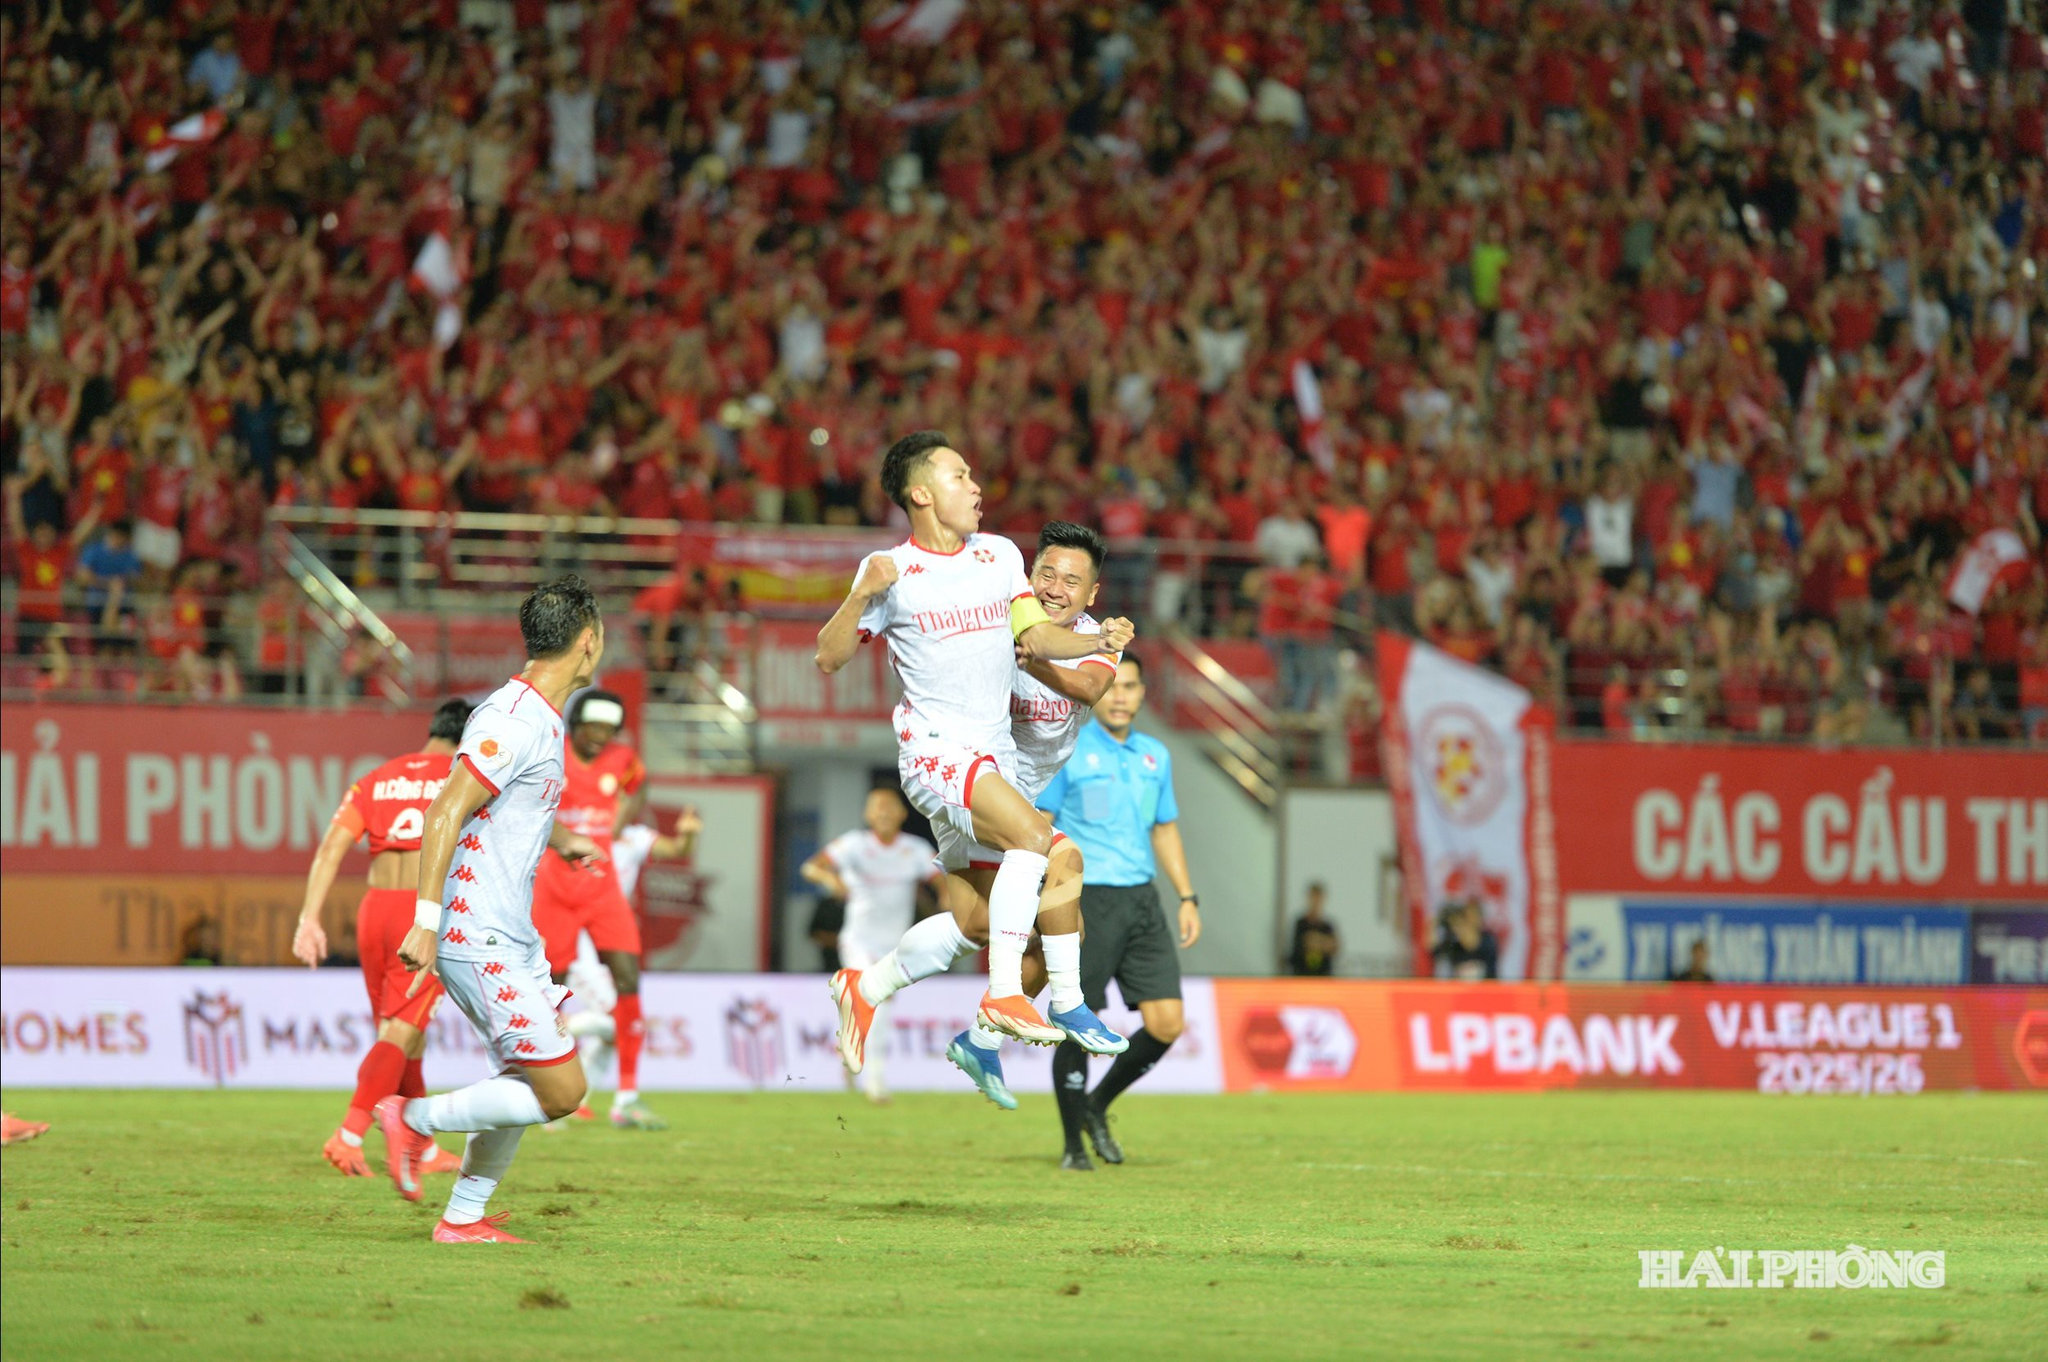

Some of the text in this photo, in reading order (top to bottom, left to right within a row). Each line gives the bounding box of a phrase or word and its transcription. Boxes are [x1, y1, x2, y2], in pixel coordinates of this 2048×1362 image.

[126, 732, 388, 853] PHÒN
[1634, 773, 1781, 882] CÁC
[1410, 1013, 1683, 1075] LPBANK
[1706, 1002, 1962, 1050] V.LEAGUE 1
[1755, 1052, 1925, 1097] 2025/26
